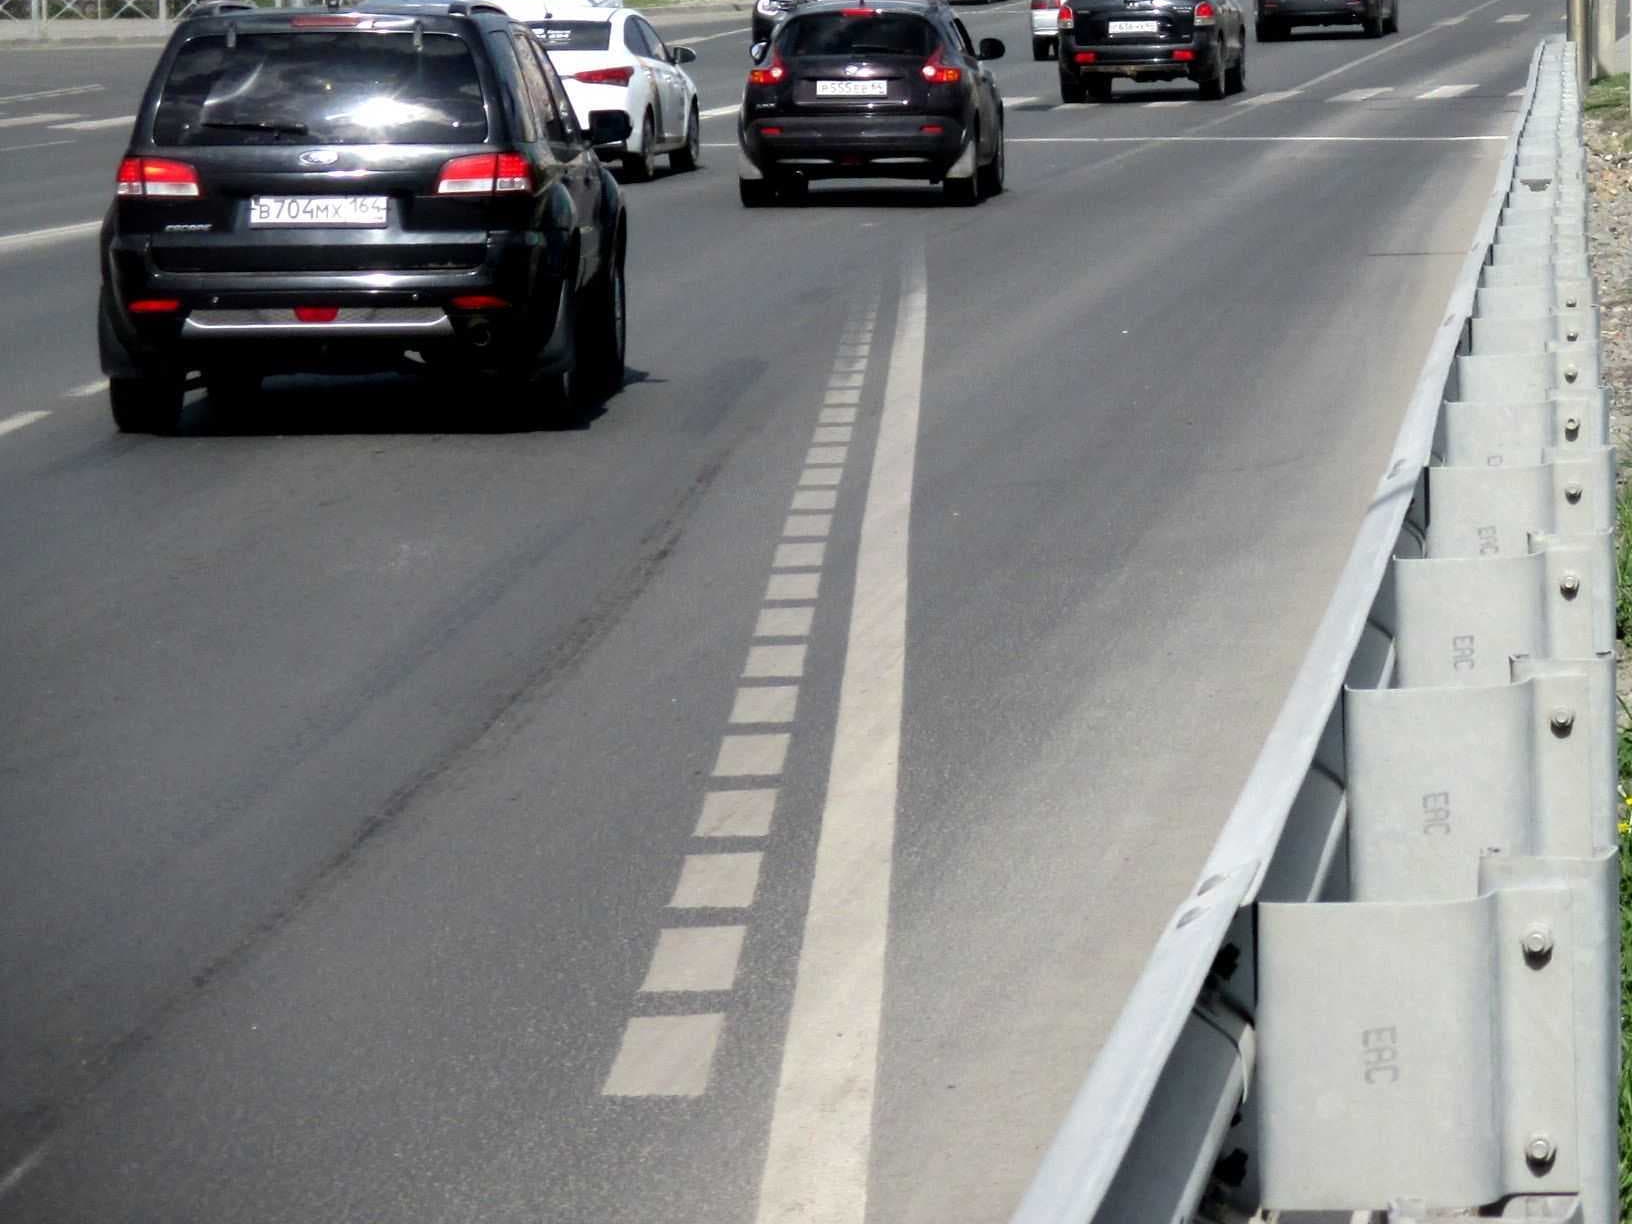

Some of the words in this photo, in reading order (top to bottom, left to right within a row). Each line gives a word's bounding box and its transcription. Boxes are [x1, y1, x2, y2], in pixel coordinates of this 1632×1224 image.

[1453, 635, 1475, 670] EAC
[1422, 791, 1451, 835] EAC
[1361, 1025, 1399, 1085] EAC
